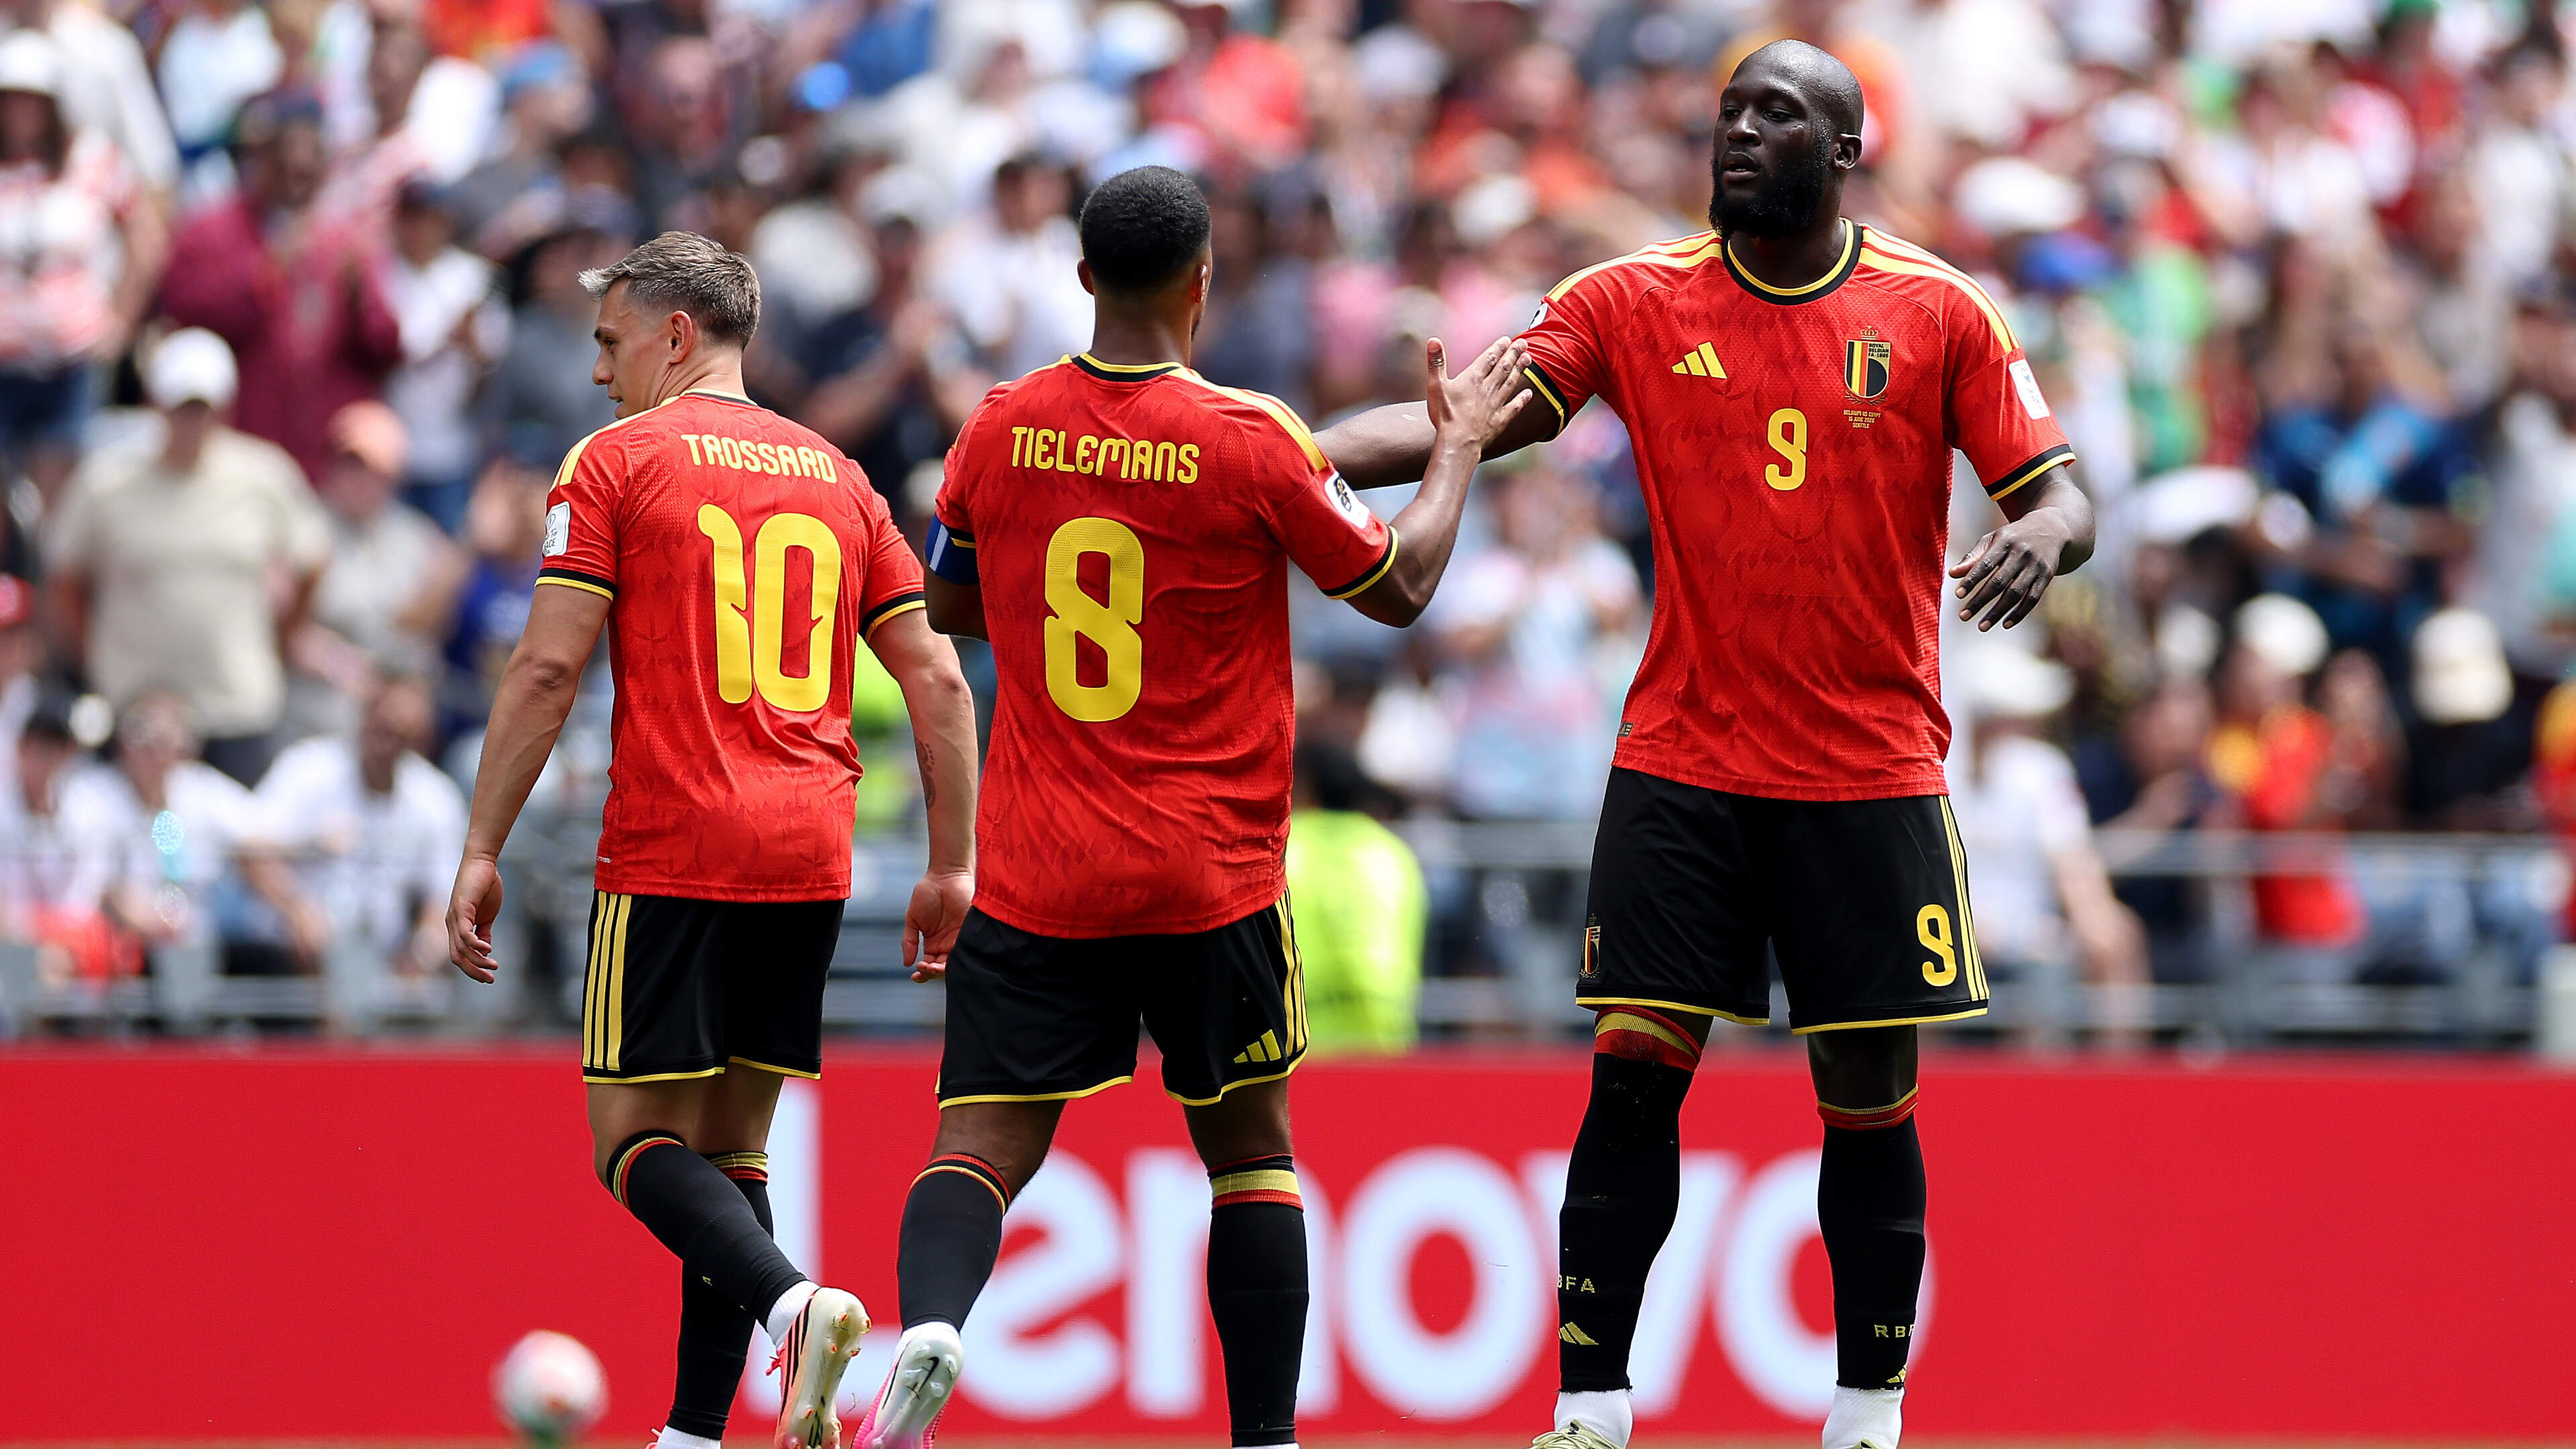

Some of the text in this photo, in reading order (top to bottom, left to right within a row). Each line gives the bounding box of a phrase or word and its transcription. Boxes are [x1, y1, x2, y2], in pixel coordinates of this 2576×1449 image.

[680, 434, 838, 484] TROSSARD
[1012, 427, 1200, 484] TIELEMANS
[1765, 408, 1807, 490] 9
[698, 504, 841, 712] 10
[1044, 517, 1144, 722] 8
[1916, 904, 1958, 987] 9
[748, 1081, 1939, 1428] Lenovo
